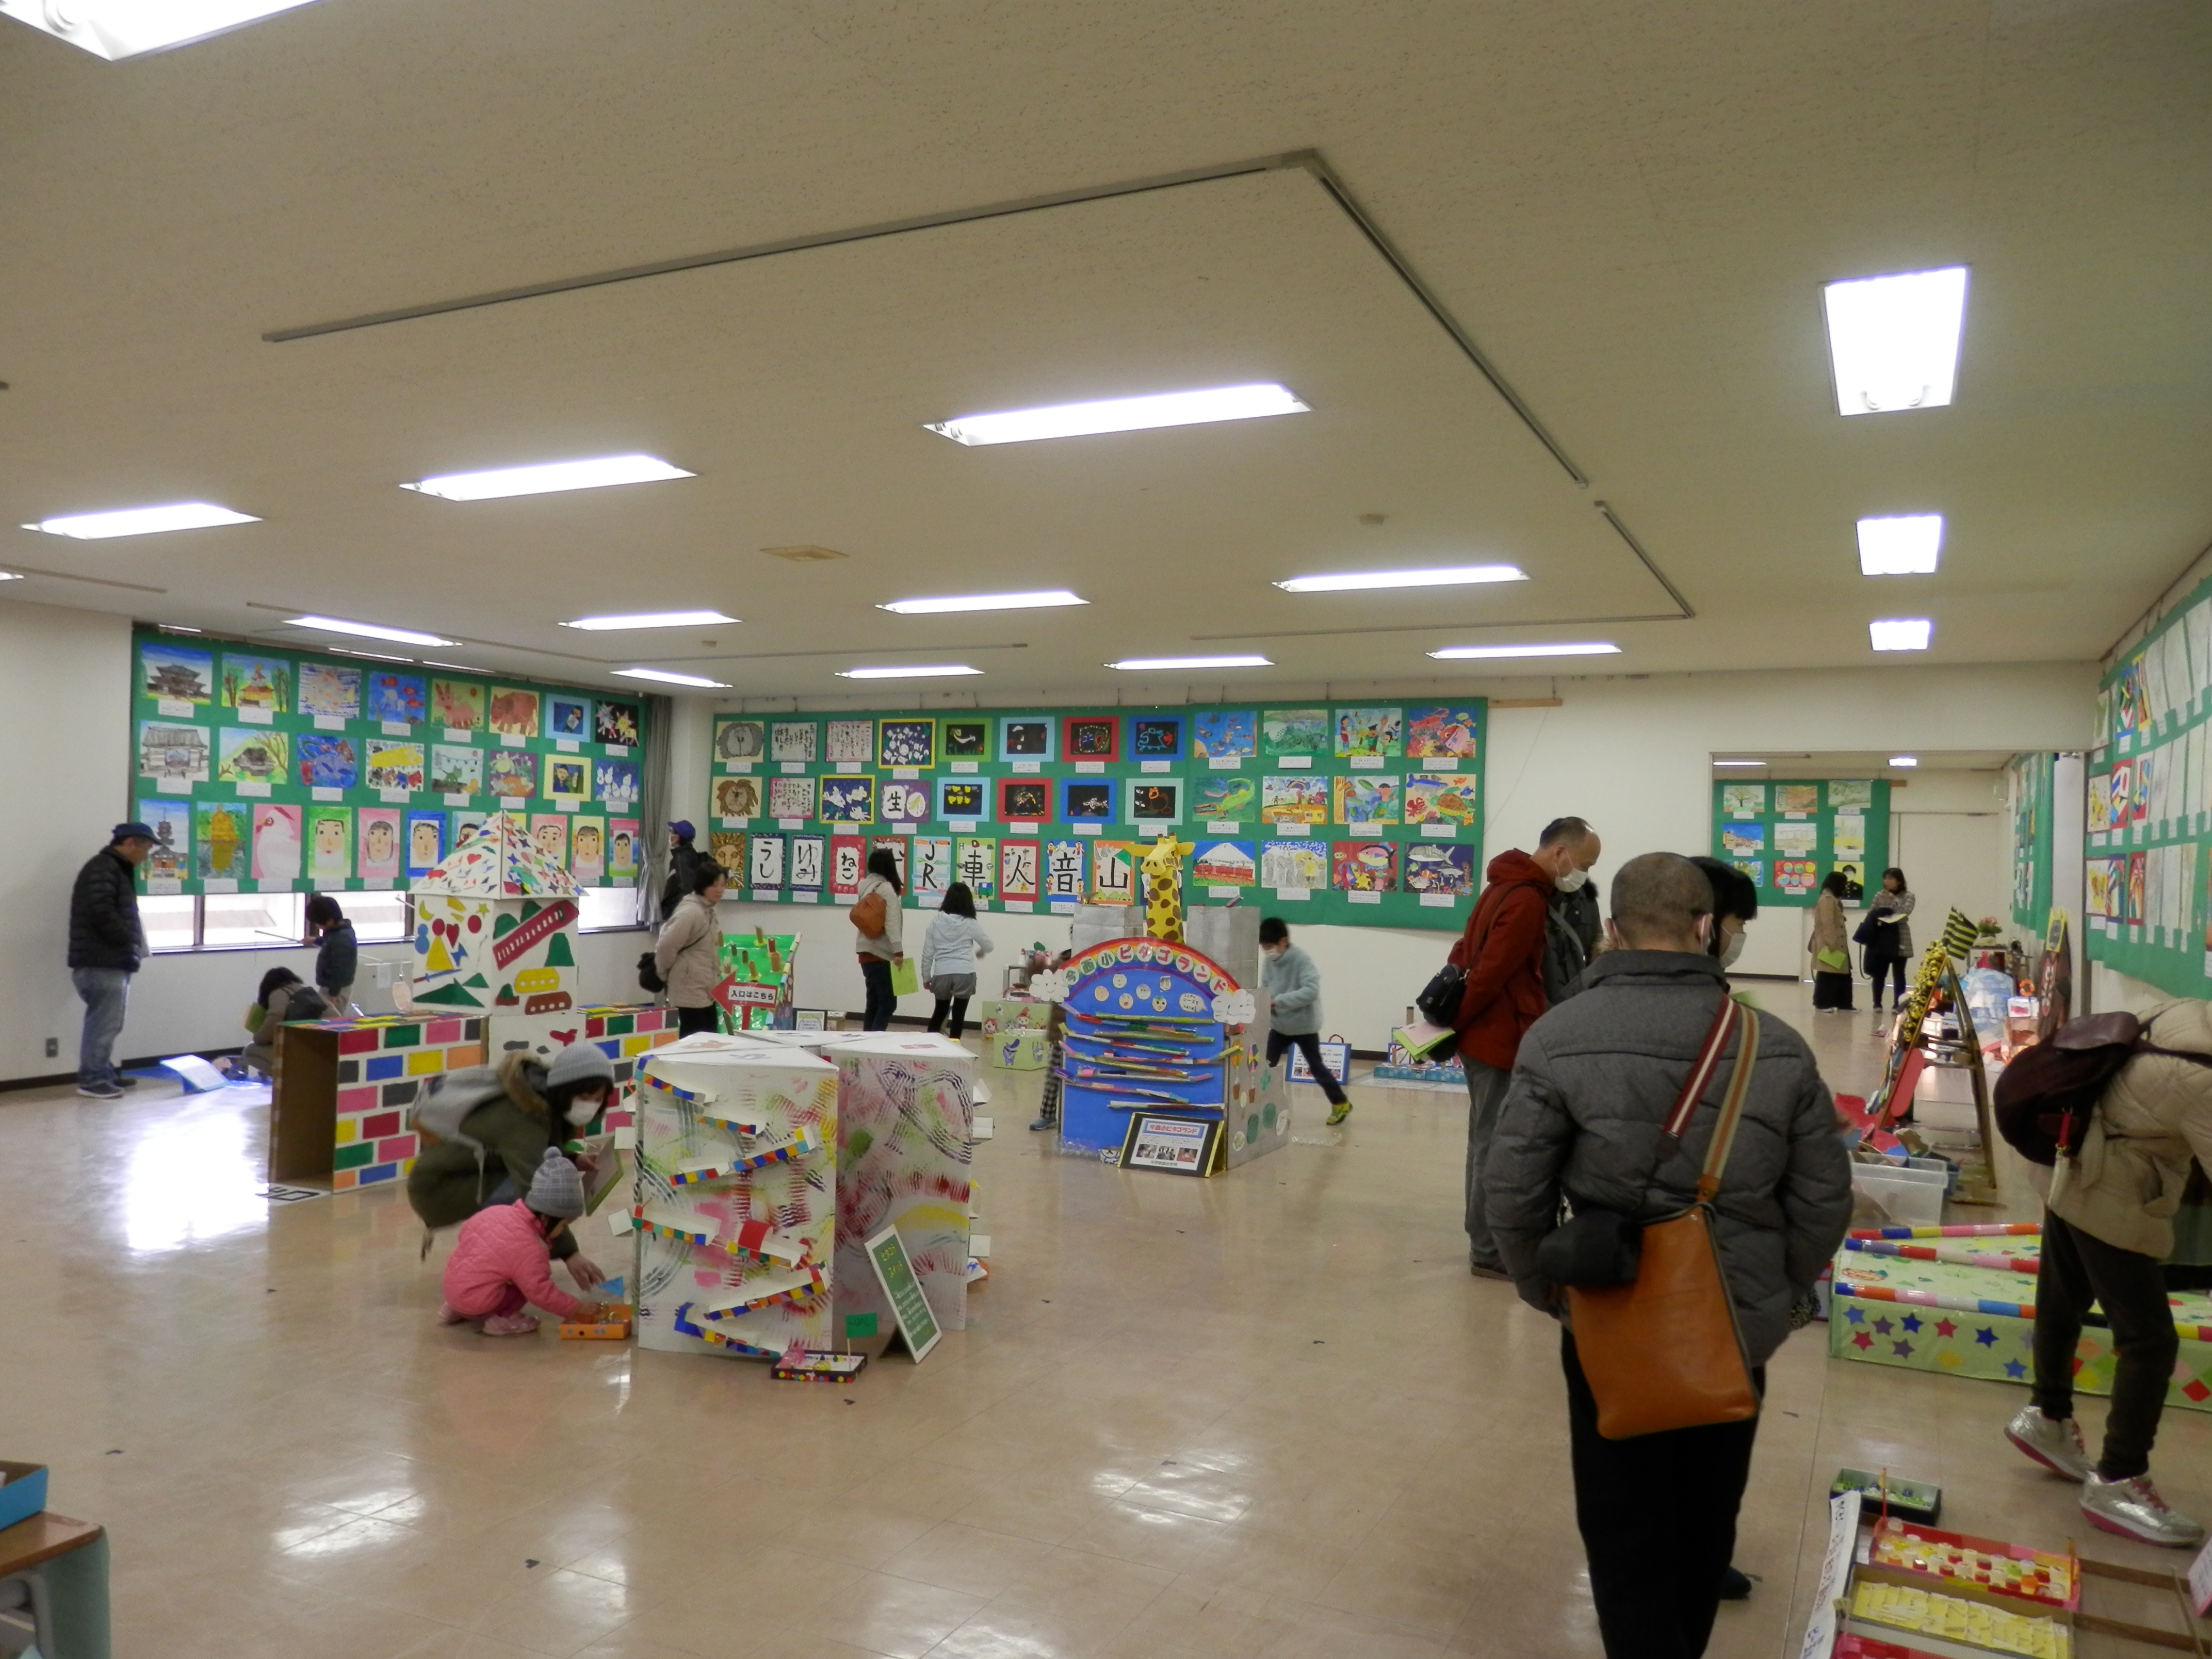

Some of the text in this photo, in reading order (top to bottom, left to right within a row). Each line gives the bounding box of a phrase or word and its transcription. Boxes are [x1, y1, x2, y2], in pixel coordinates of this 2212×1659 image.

[887, 791, 902, 812] 生
[759, 841, 774, 879] うし
[796, 843, 819, 882] ゆみ
[841, 852, 857, 880] ねこ
[922, 843, 938, 889] JR
[962, 849, 986, 887] 車
[1053, 852, 1078, 893] 音
[1099, 857, 1128, 889] 山
[1065, 945, 1226, 990] 今西小ピタゴランド
[731, 989, 774, 1000] 入口はこちら
